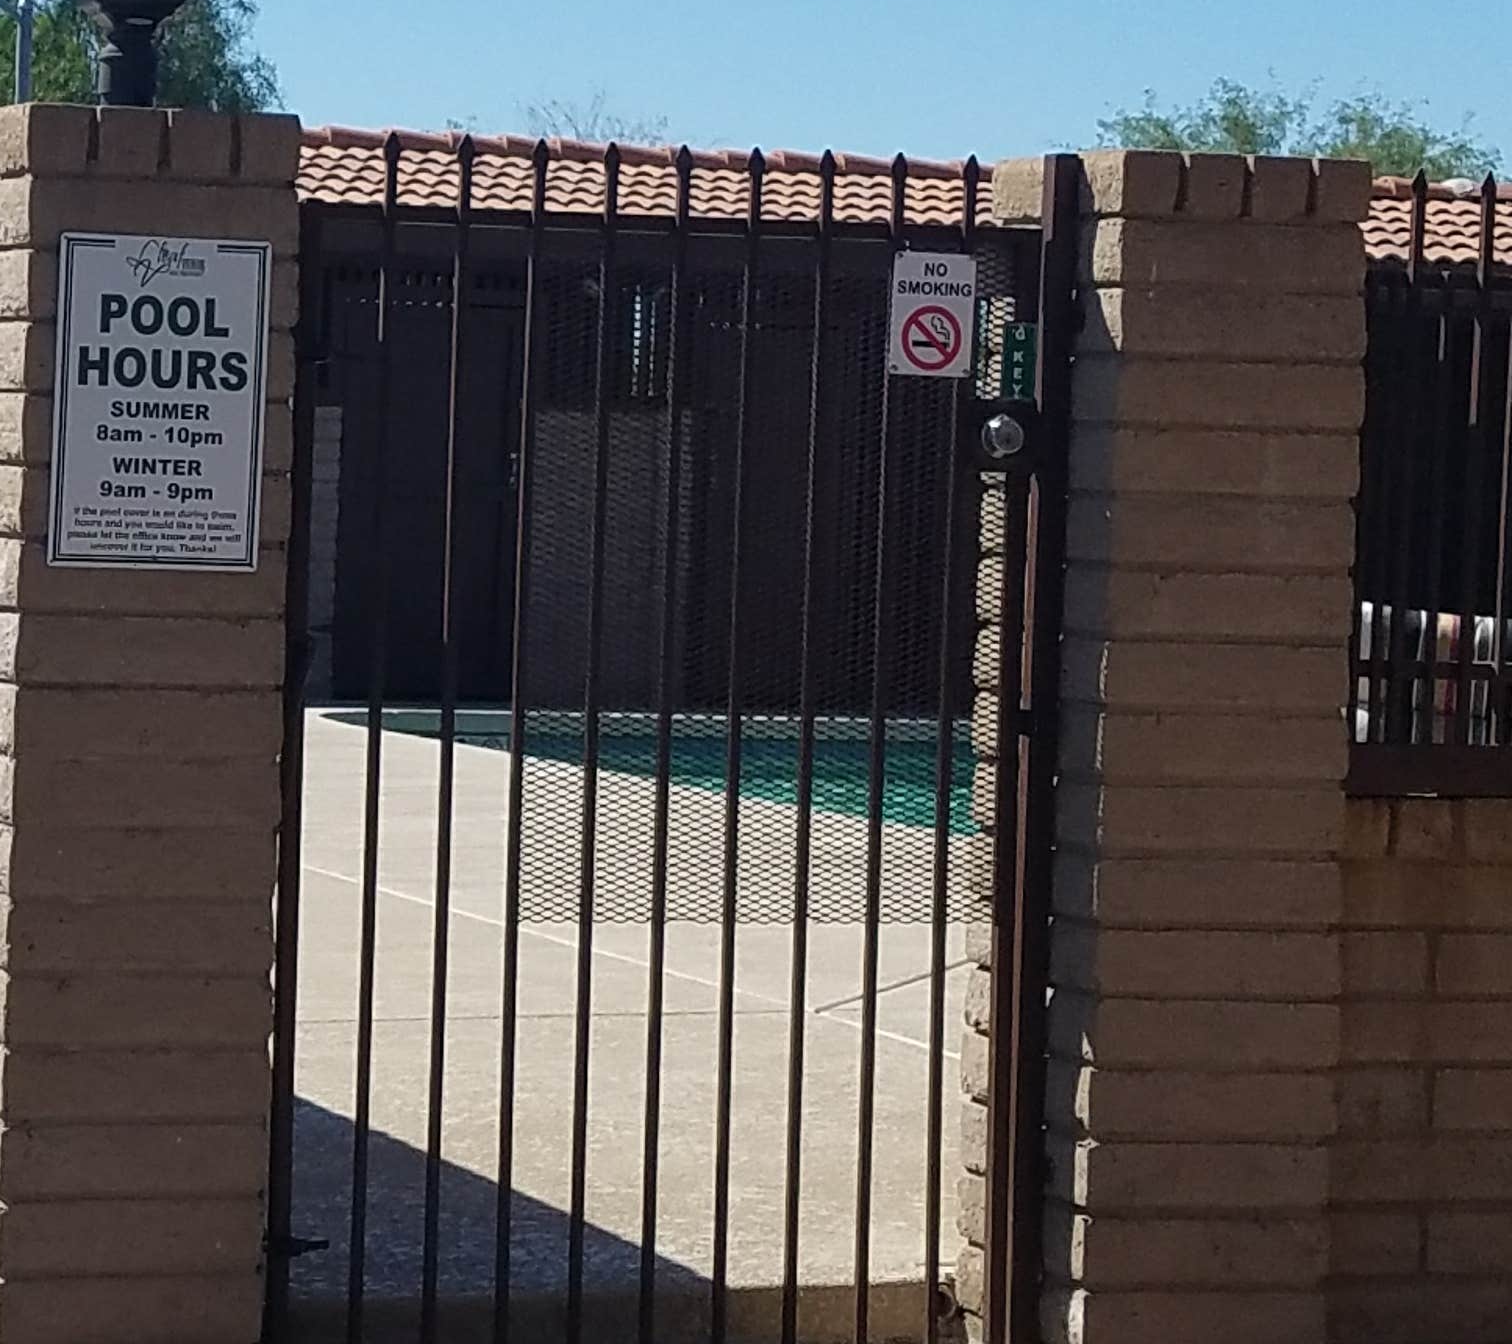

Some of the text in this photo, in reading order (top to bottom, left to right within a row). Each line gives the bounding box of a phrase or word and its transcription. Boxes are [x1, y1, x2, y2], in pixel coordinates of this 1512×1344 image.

[924, 263, 948, 277] NO
[897, 281, 973, 297] SMOKING
[99, 293, 229, 338] POOL
[77, 346, 248, 391] HOURS
[111, 401, 210, 421] SUMMER
[96, 425, 143, 443] 8am
[165, 427, 223, 447] 10pm
[113, 457, 202, 477] WINTER
[100, 480, 146, 499] 9am
[169, 482, 214, 503] 9pm
